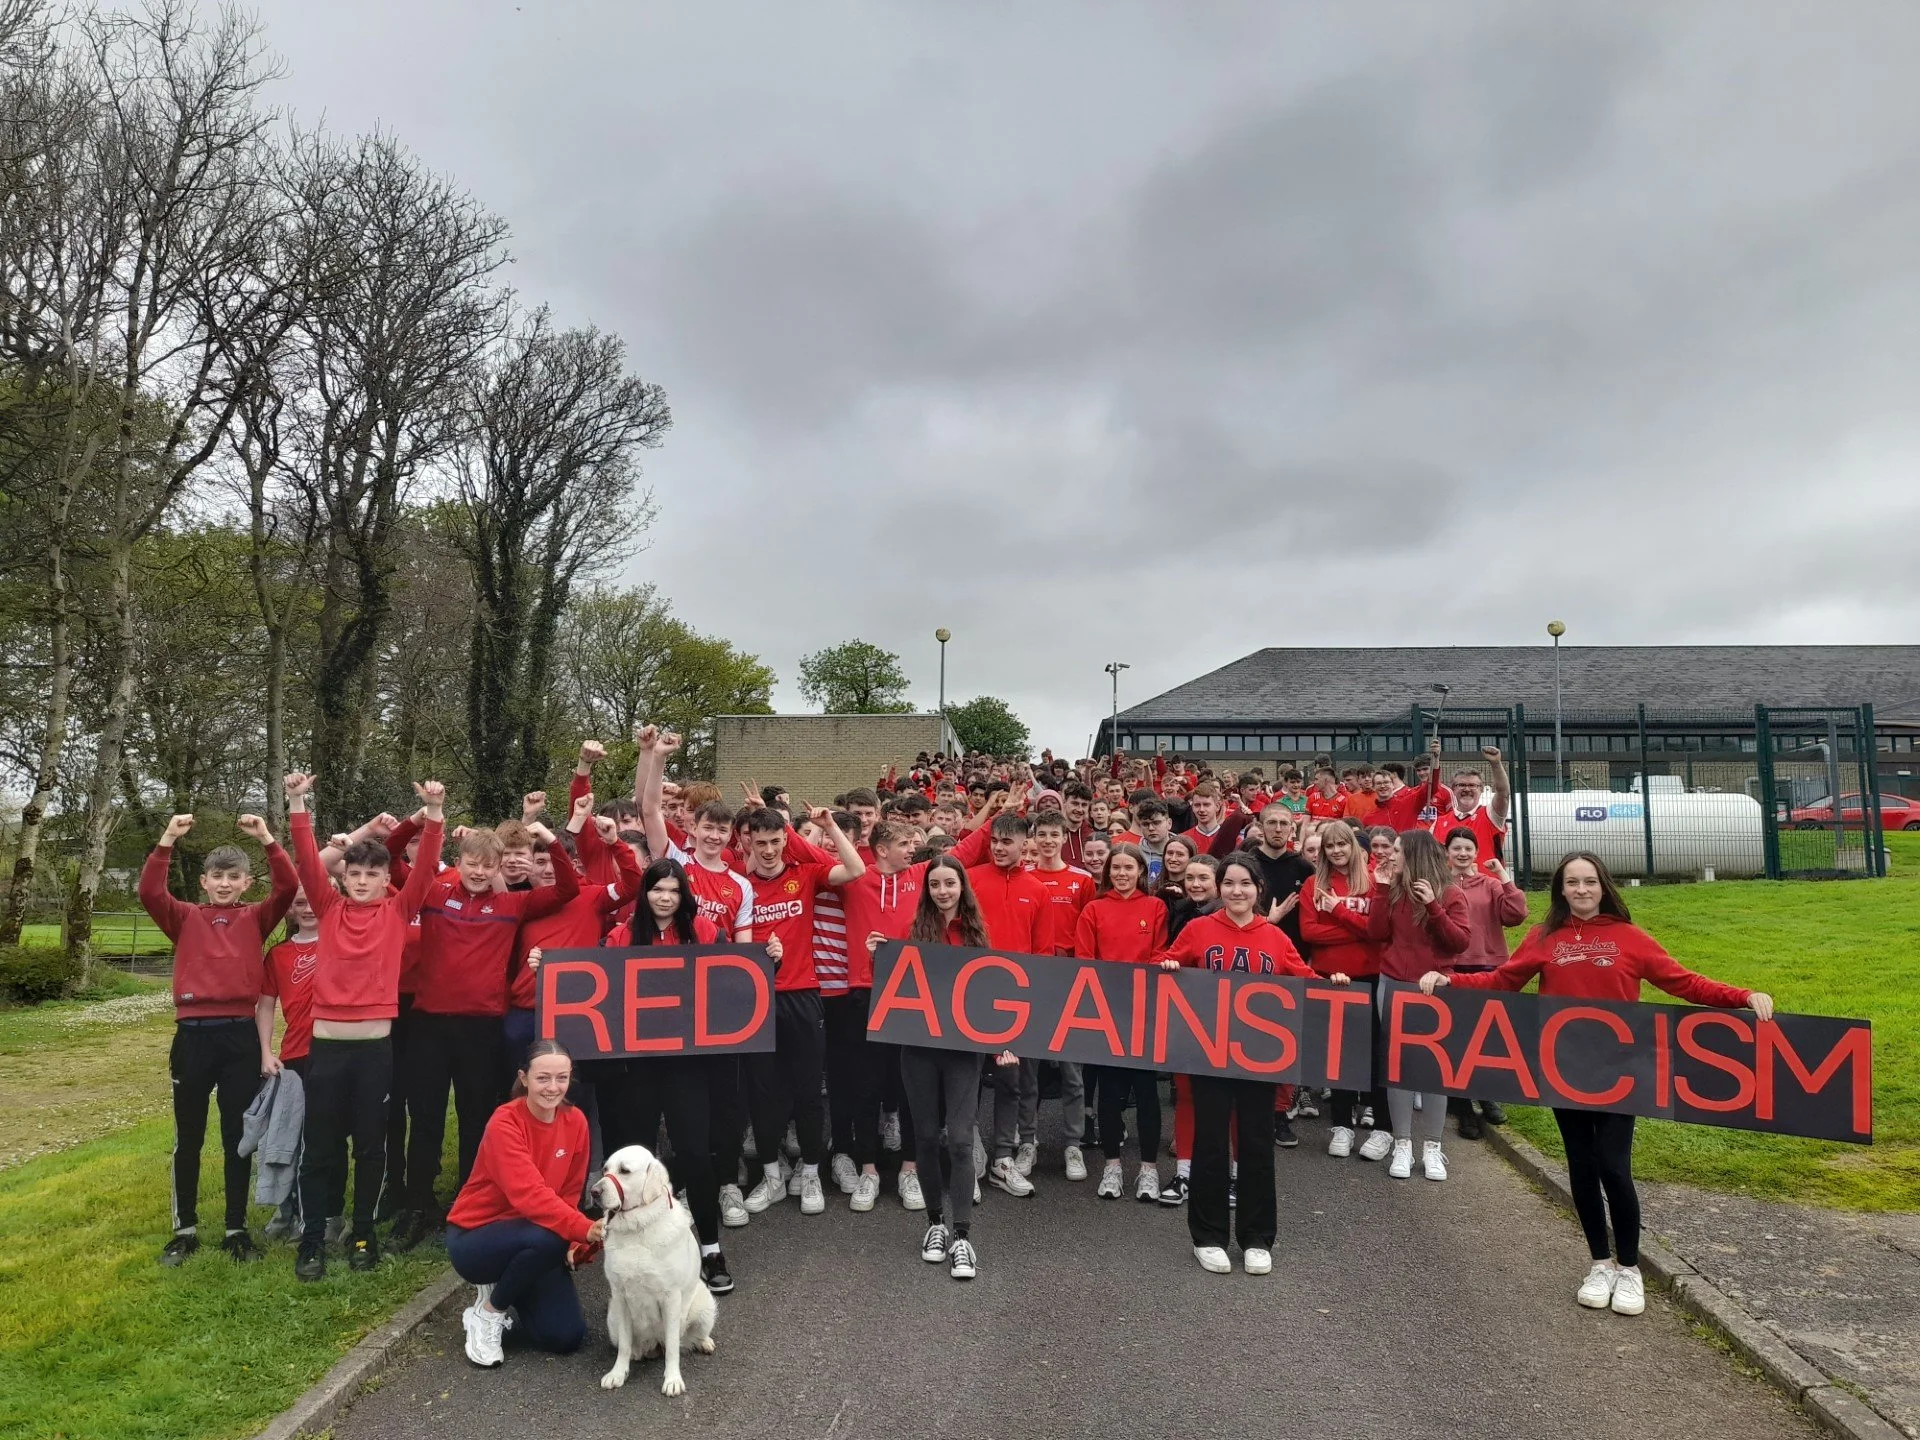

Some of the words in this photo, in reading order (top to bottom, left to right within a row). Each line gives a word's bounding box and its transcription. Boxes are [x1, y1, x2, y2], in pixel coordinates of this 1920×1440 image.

[1580, 809, 1603, 818] FLO
[900, 881, 916, 893] JW
[754, 902, 787, 916] Team
[753, 910, 788, 924] iewer
[541, 954, 770, 1052] RED
[866, 945, 1370, 1081] AGAINST
[1387, 990, 1871, 1135] RACISM
